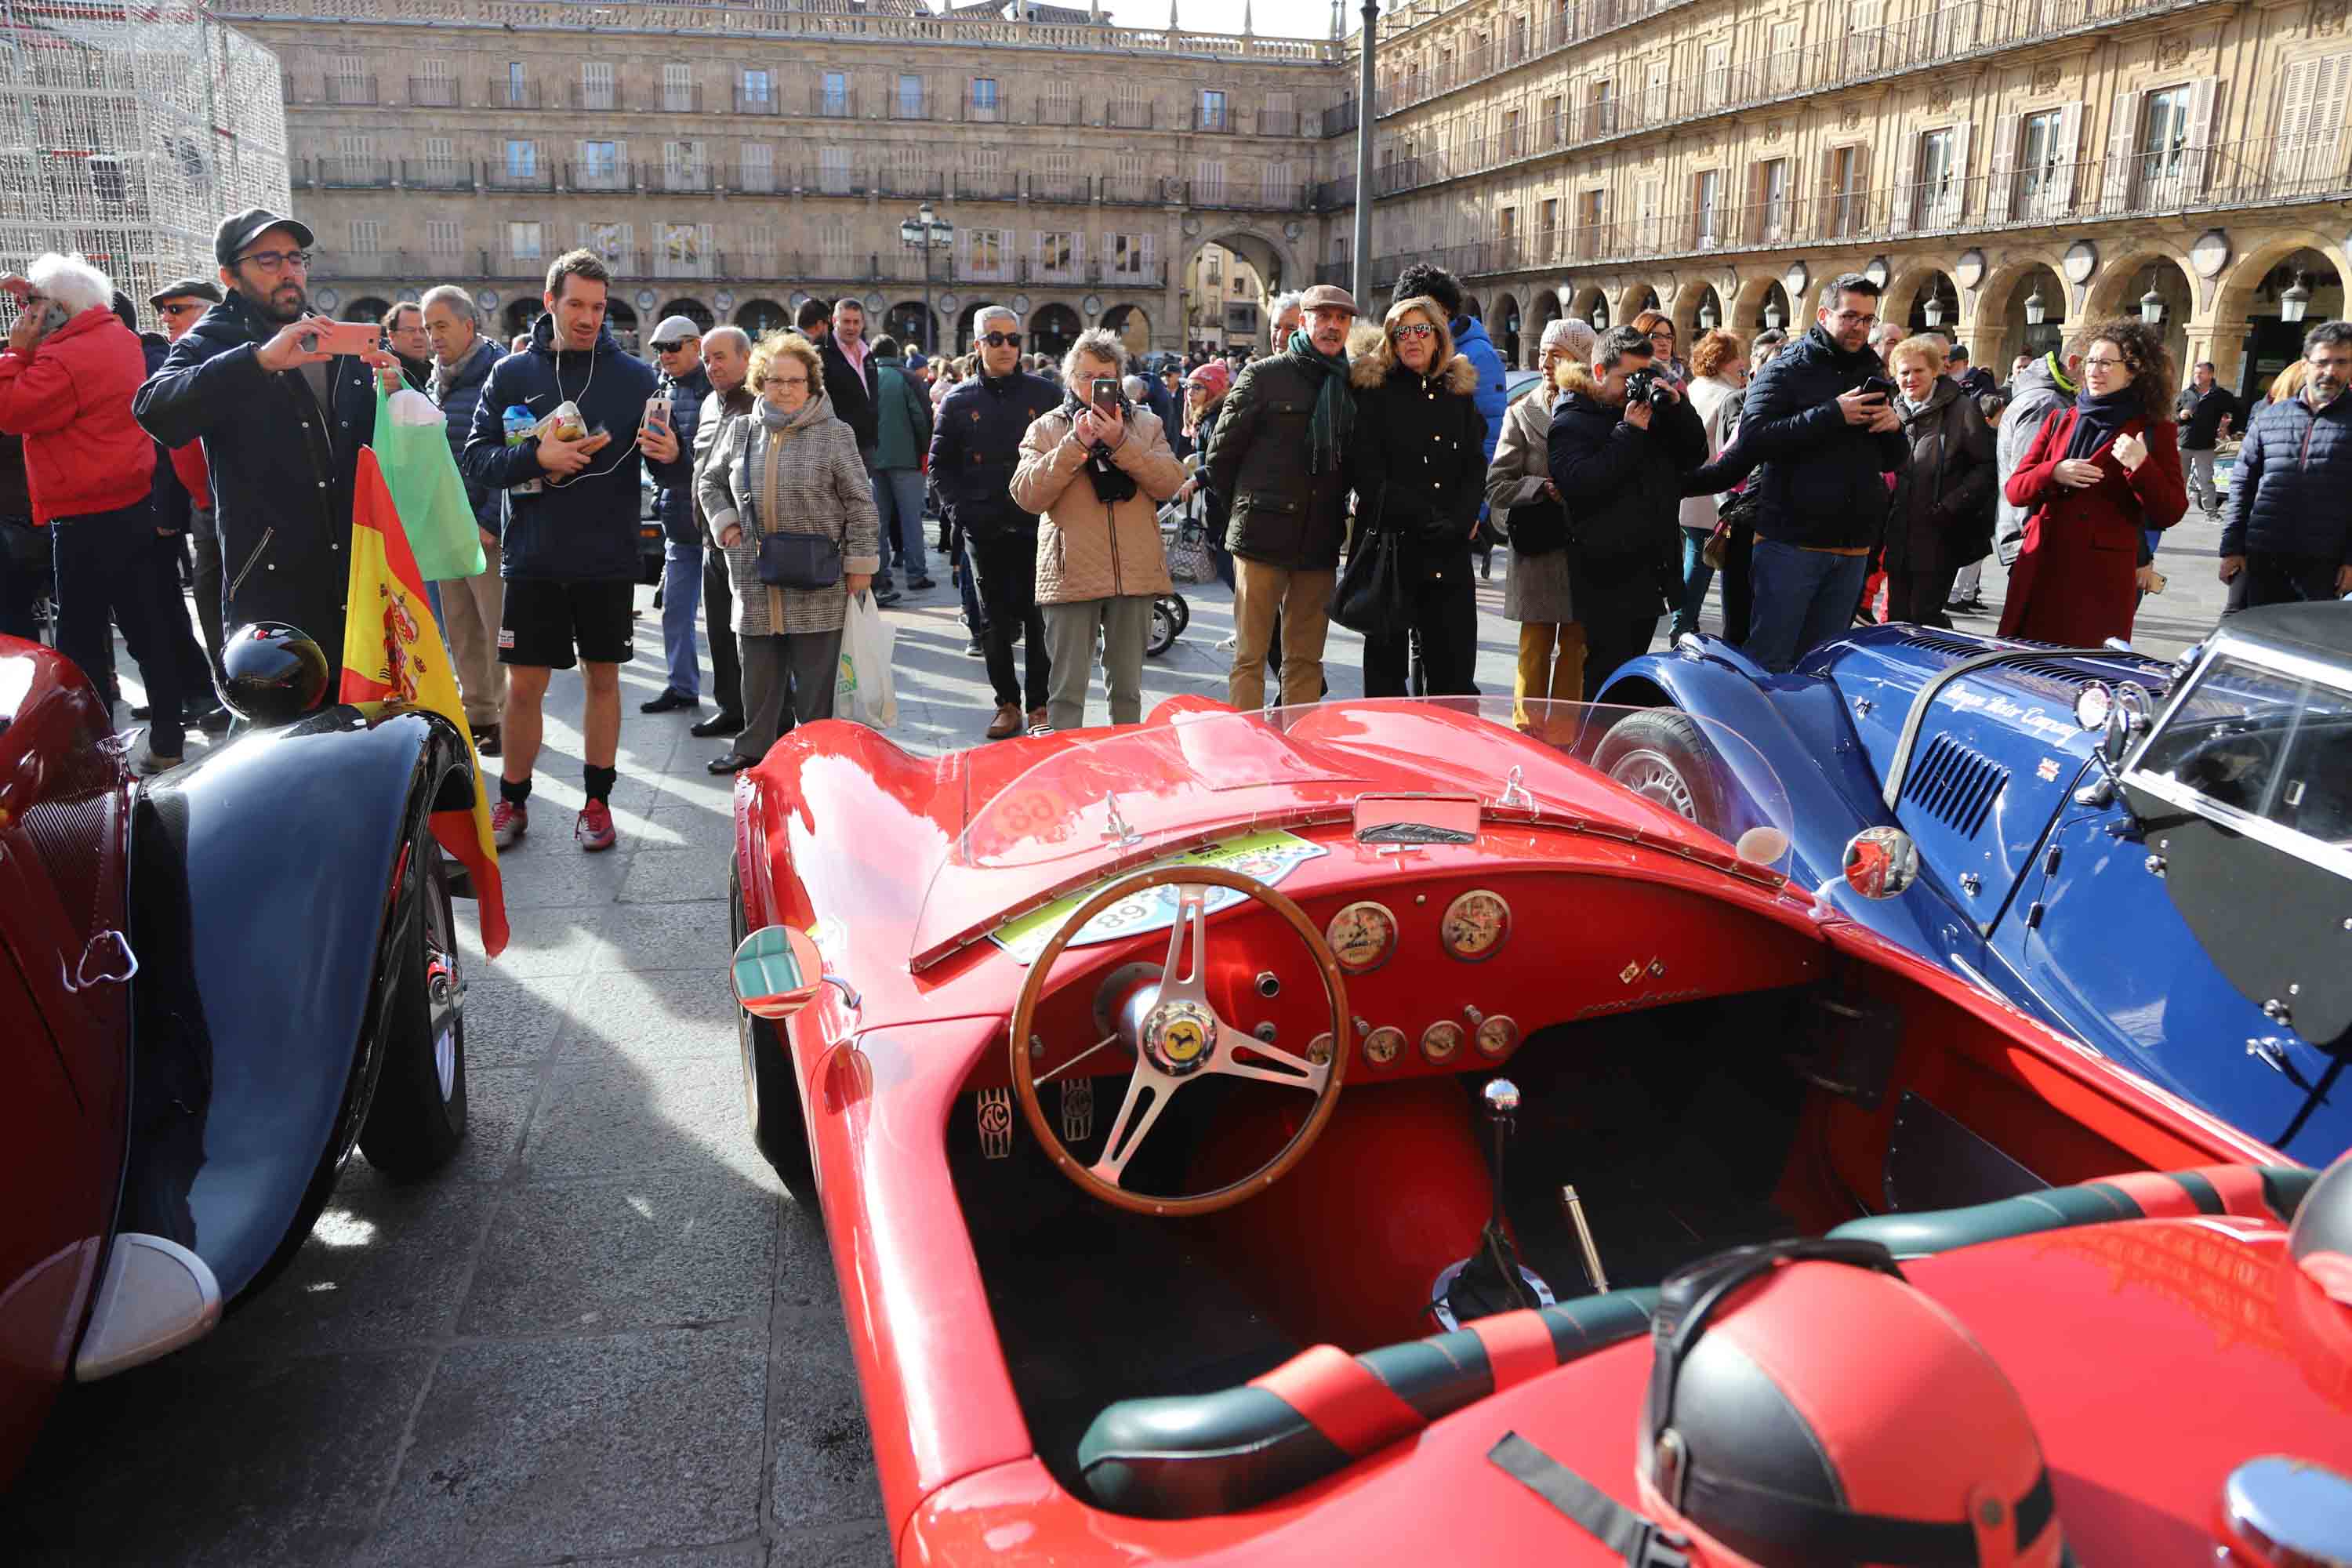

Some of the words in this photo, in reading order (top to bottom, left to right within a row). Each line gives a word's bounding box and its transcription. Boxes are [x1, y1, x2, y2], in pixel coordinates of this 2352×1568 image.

[1944, 683, 1987, 713] Morgan
[1985, 696, 2024, 718] Motor
[2021, 707, 2082, 747] Company
